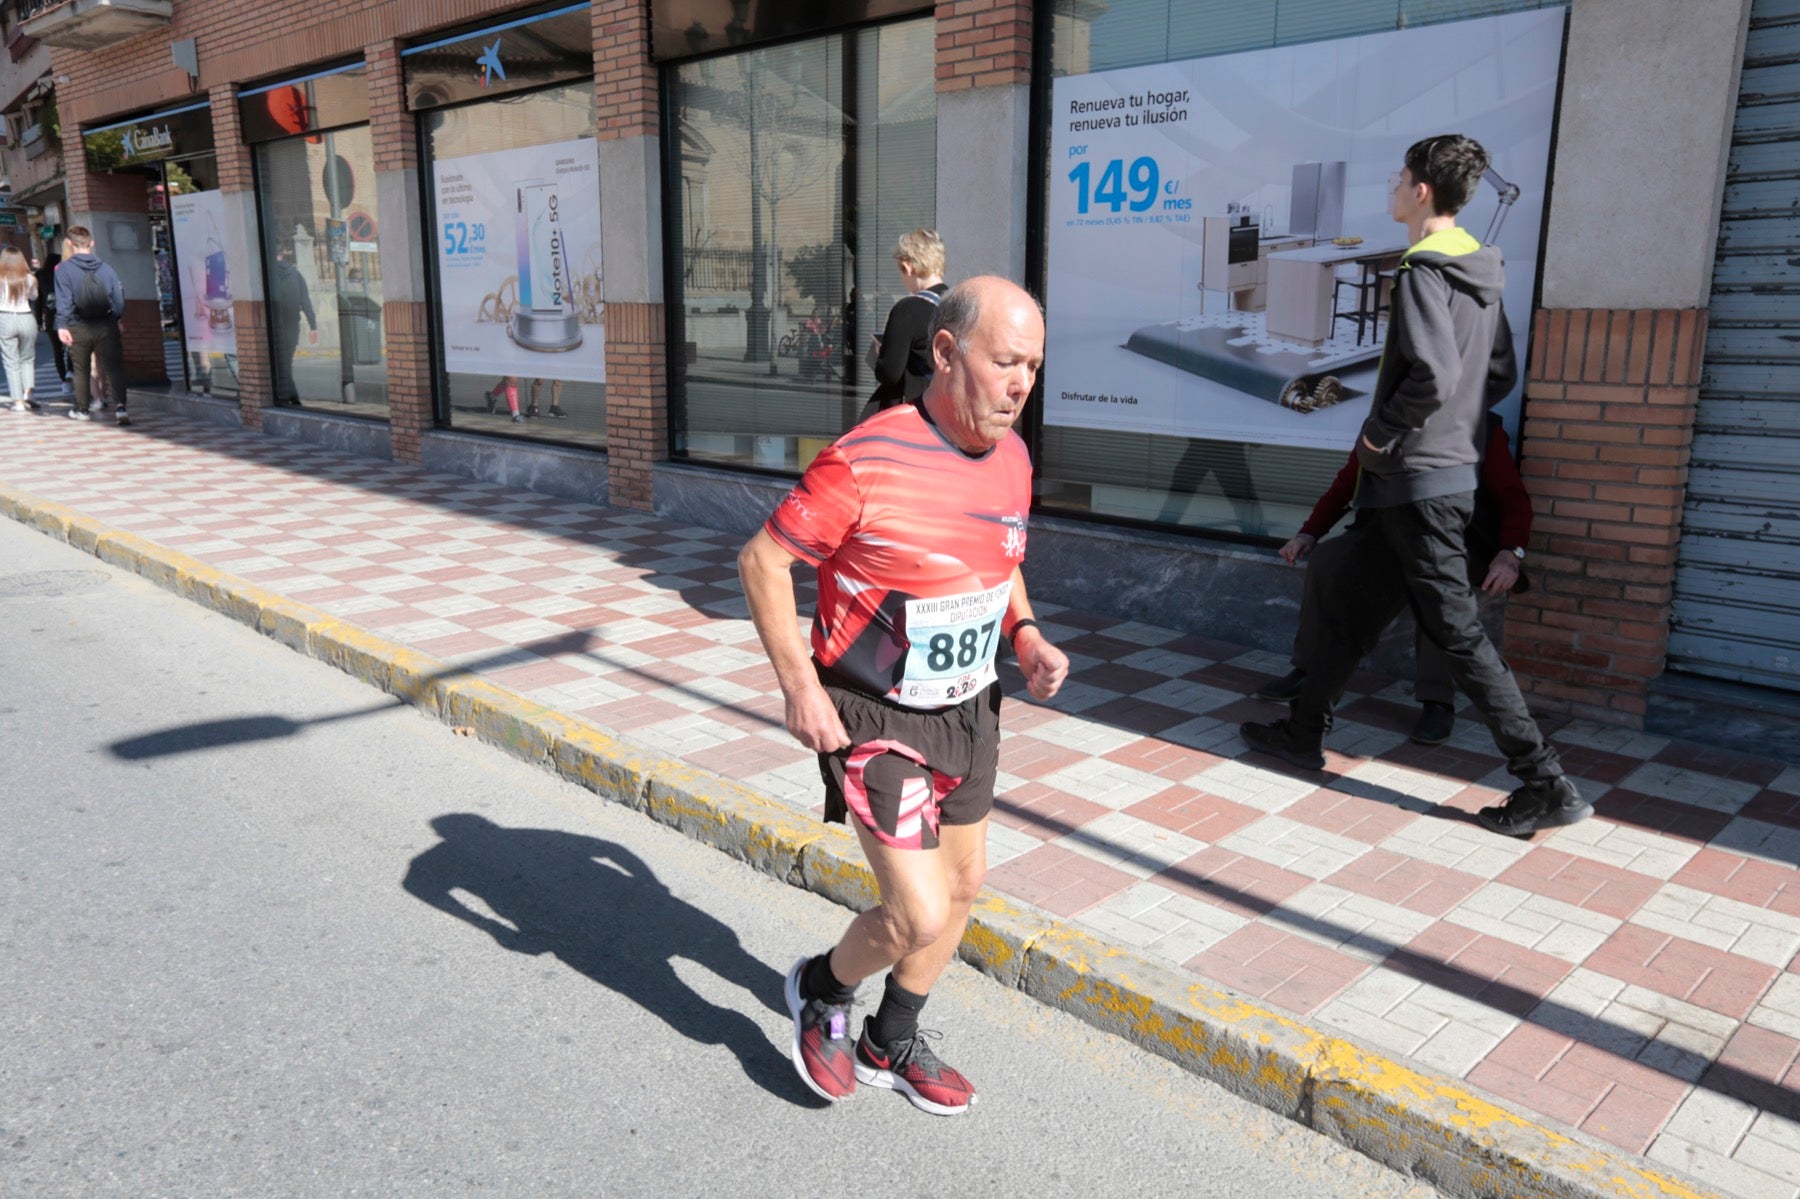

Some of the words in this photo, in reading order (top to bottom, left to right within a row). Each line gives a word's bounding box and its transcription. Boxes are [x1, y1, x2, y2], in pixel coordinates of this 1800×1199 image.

[1070, 97, 1125, 114] Renueva
[1130, 94, 1143, 107] tu
[1147, 89, 1190, 107] hogar,
[1070, 116, 1121, 132] renueva
[1125, 113, 1139, 126] tu
[1143, 107, 1187, 125] ilusión
[1068, 144, 1089, 159] por
[1068, 156, 1160, 215] 149
[548, 194, 559, 222] 5G
[1163, 197, 1193, 211] mes
[1085, 218, 1105, 226] meses
[550, 228, 562, 306] Note10+
[1061, 391, 1096, 402] Disfrutar
[1098, 394, 1108, 403] de
[1110, 394, 1118, 404] la
[1120, 395, 1138, 405] vida
[915, 602, 938, 614] XXXIII
[940, 599, 960, 612] GRAN
[961, 595, 985, 608] PREMIO
[986, 592, 994, 602] DE
[927, 618, 996, 672] 887
